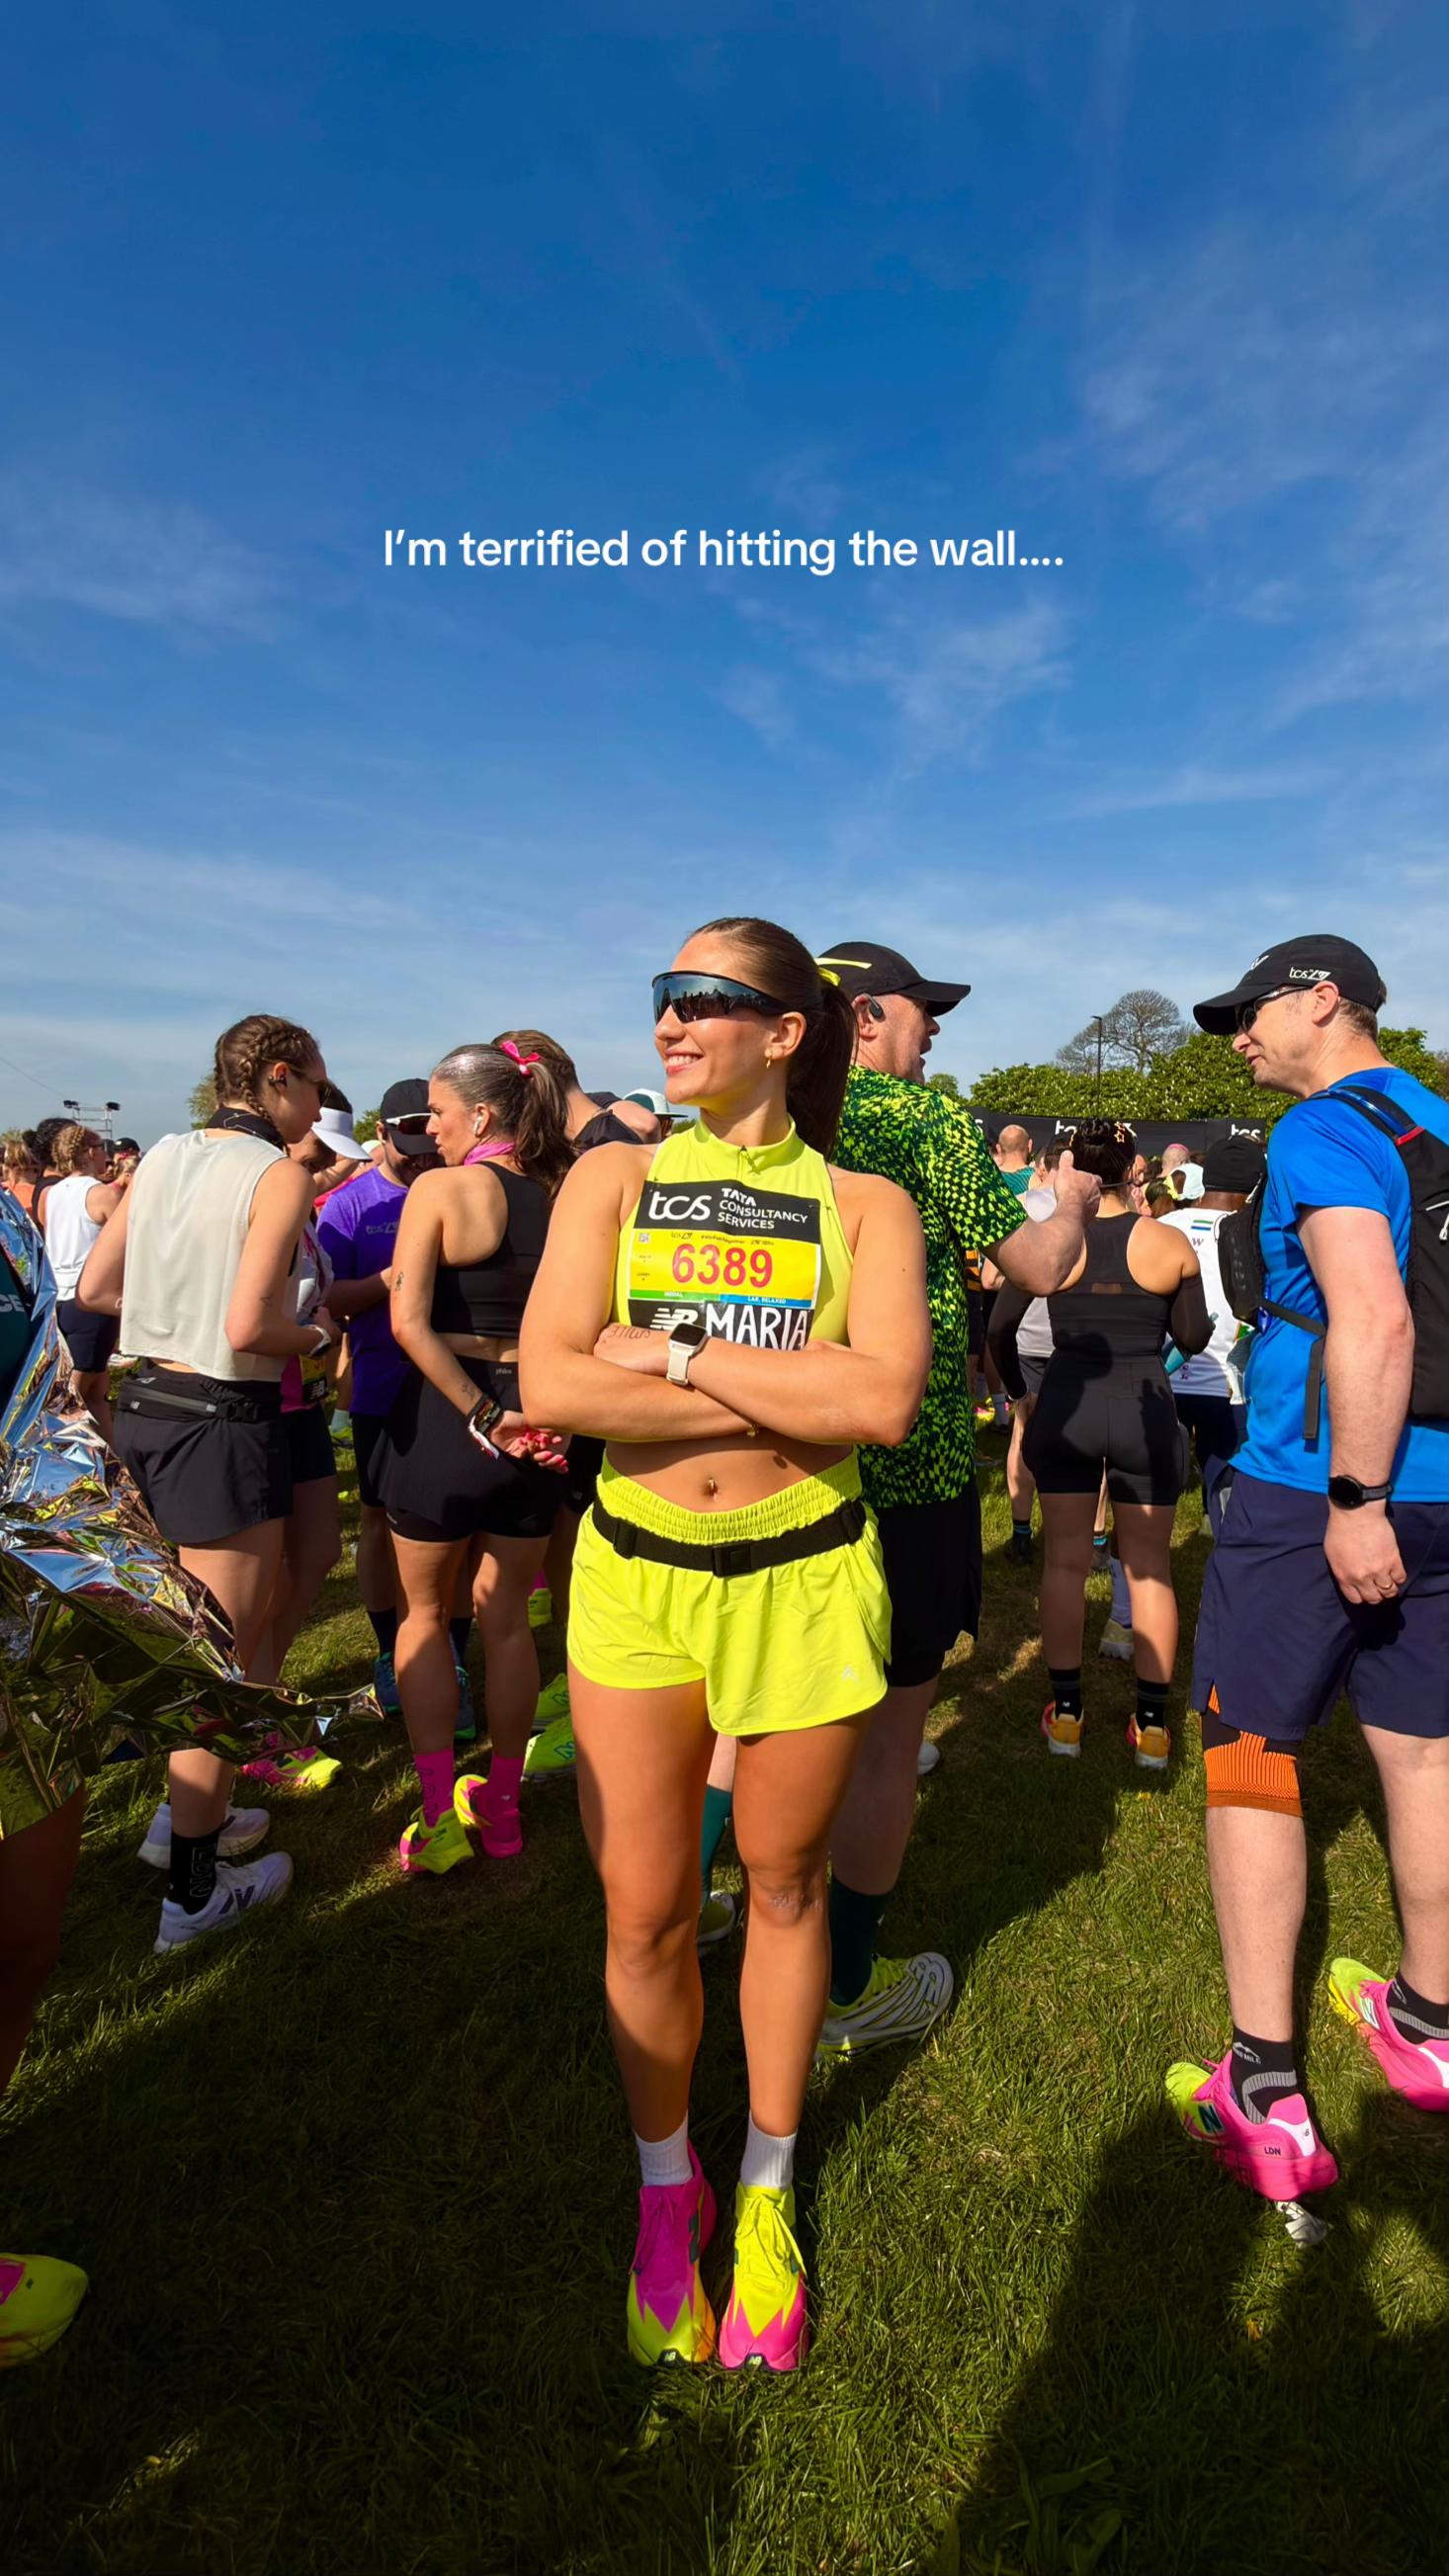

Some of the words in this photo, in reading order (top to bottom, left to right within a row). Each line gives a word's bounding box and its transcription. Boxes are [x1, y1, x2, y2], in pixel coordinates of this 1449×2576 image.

[1289, 967, 1309, 979] tcs
[648, 1190, 713, 1220] tcs
[722, 1188, 756, 1207] TATA
[718, 1212, 775, 1230] SERVICES
[719, 1200, 808, 1224] CONSULTANCY
[672, 1244, 773, 1288] 6389
[705, 1302, 809, 1351] MARIA
[1264, 2146, 1282, 2156] LDN
